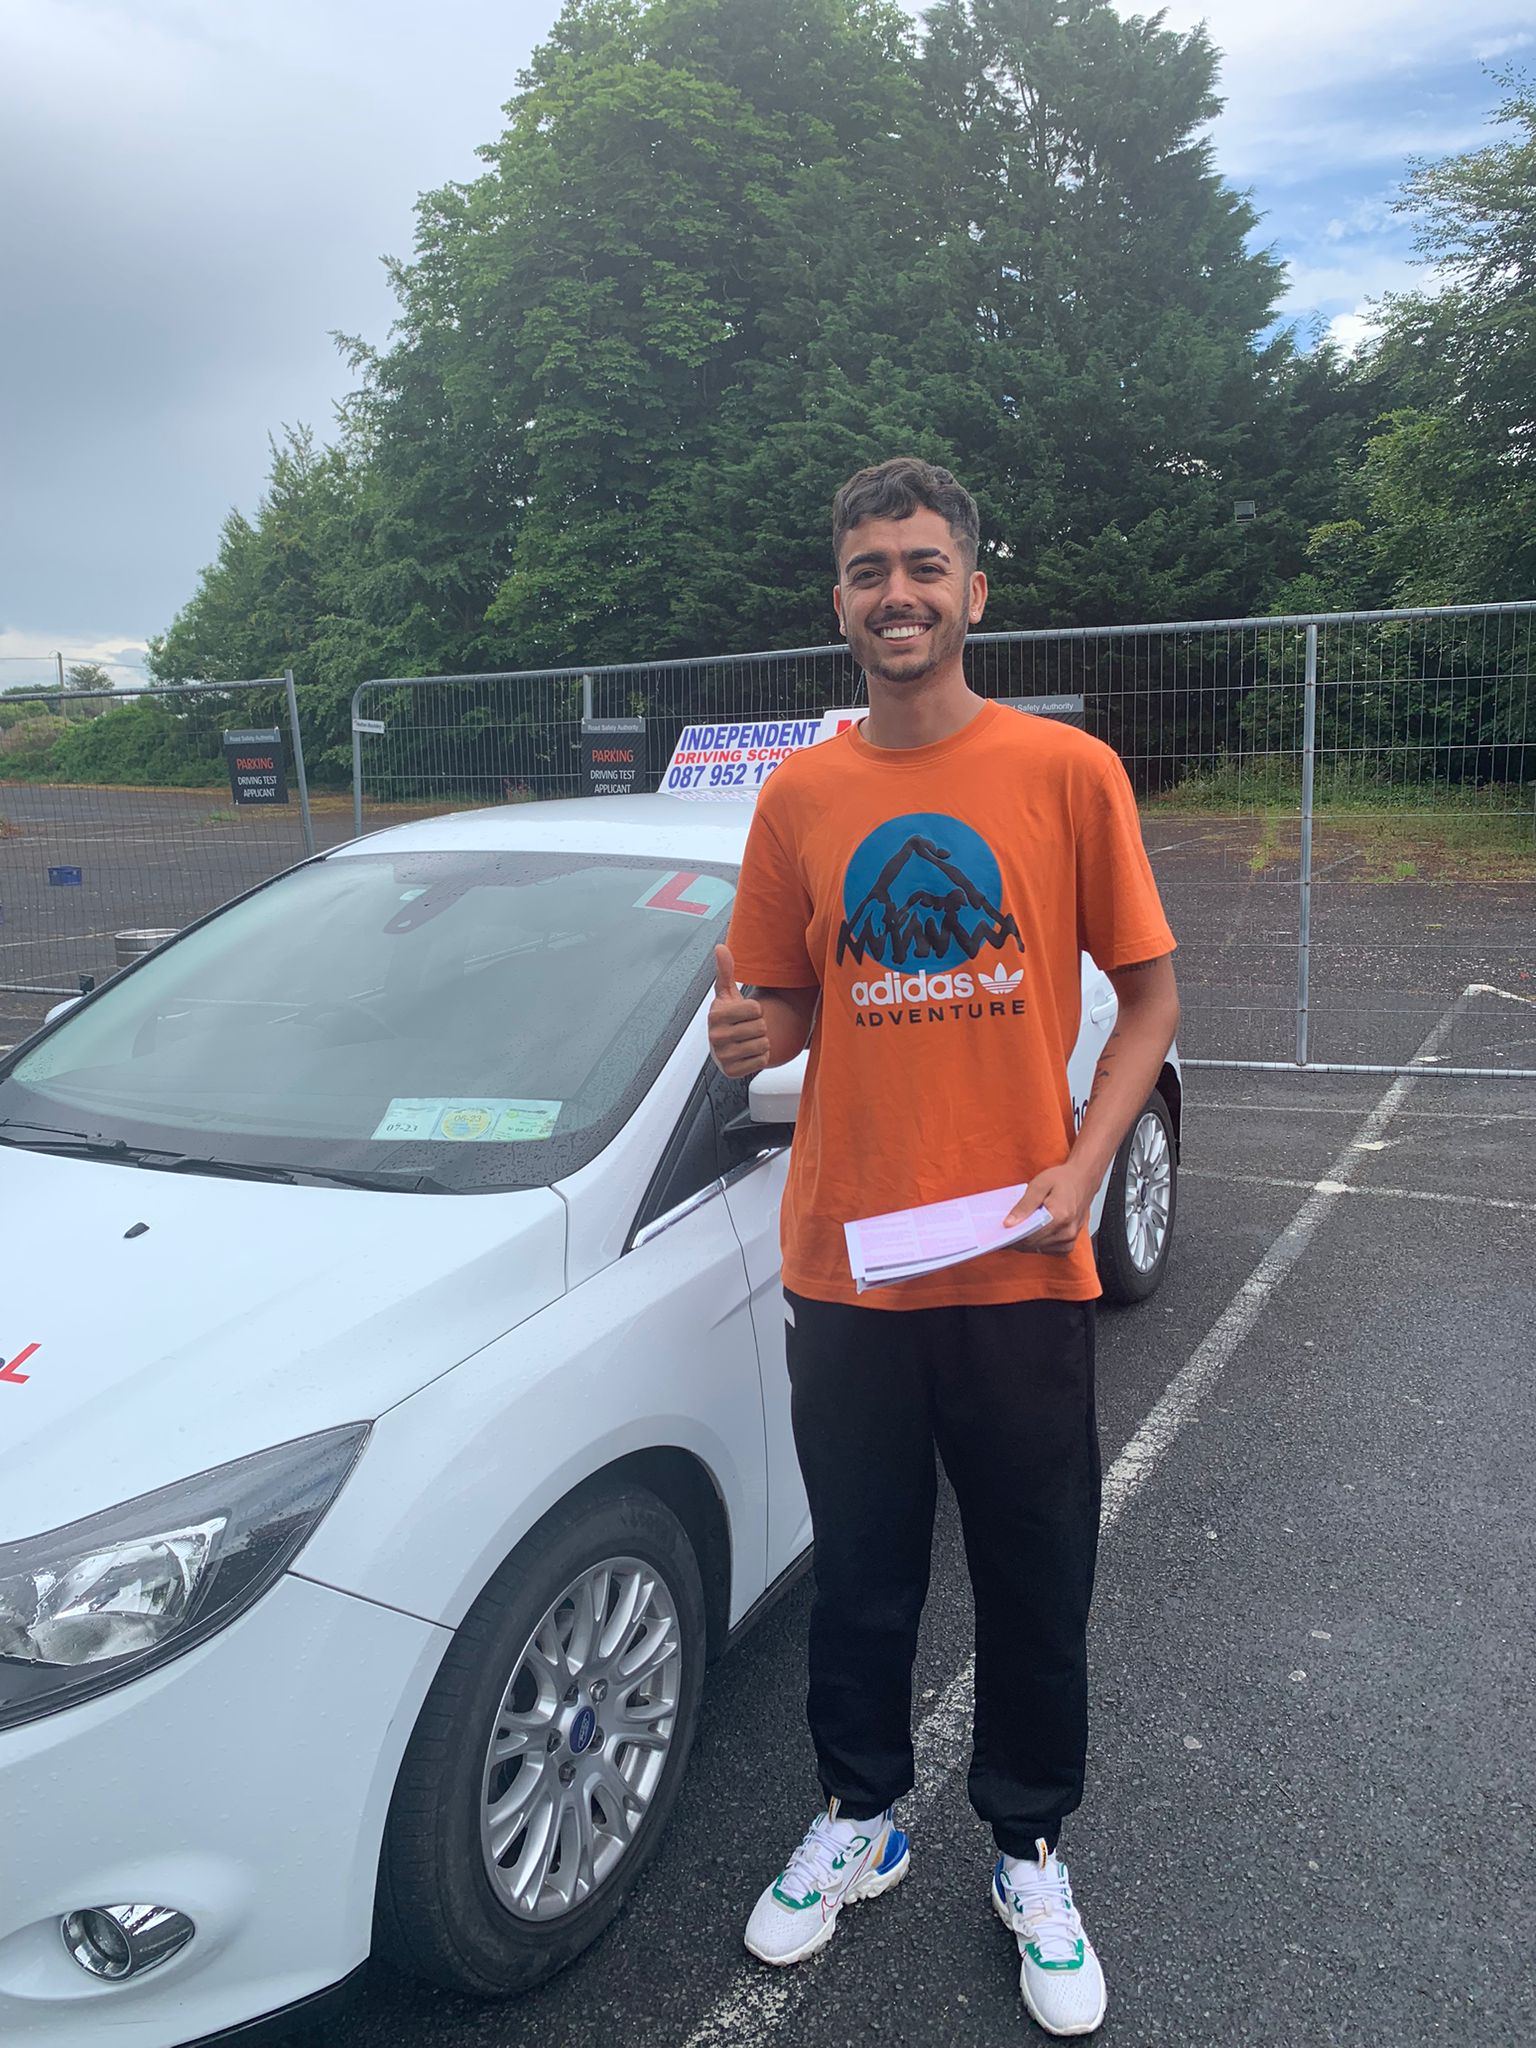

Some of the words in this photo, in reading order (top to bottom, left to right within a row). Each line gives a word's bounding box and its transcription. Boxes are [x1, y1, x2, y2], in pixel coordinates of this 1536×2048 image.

[1018, 704, 1040, 713] Safety
[1042, 702, 1074, 711] Authority
[617, 724, 639, 732] Authority
[680, 721, 821, 751] INDEPENDENT
[592, 750, 634, 762] PARKING
[674, 750, 742, 765] DRIVING
[746, 747, 804, 761] SCHO
[236, 758, 274, 769] PARKING
[237, 776, 262, 785] DRIVING
[263, 776, 277, 784] TEST
[590, 770, 618, 779] DRIVING
[619, 770, 636, 780] TEST
[668, 766, 706, 789] 087
[709, 763, 747, 787] 952
[243, 788, 275, 797] APPLICANT
[594, 784, 631, 793] APPLICANT
[645, 870, 711, 916] L
[851, 969, 975, 1006] adidas
[855, 1000, 1025, 1027] ADVENTURE
[386, 1123, 418, 1132] 07-23
